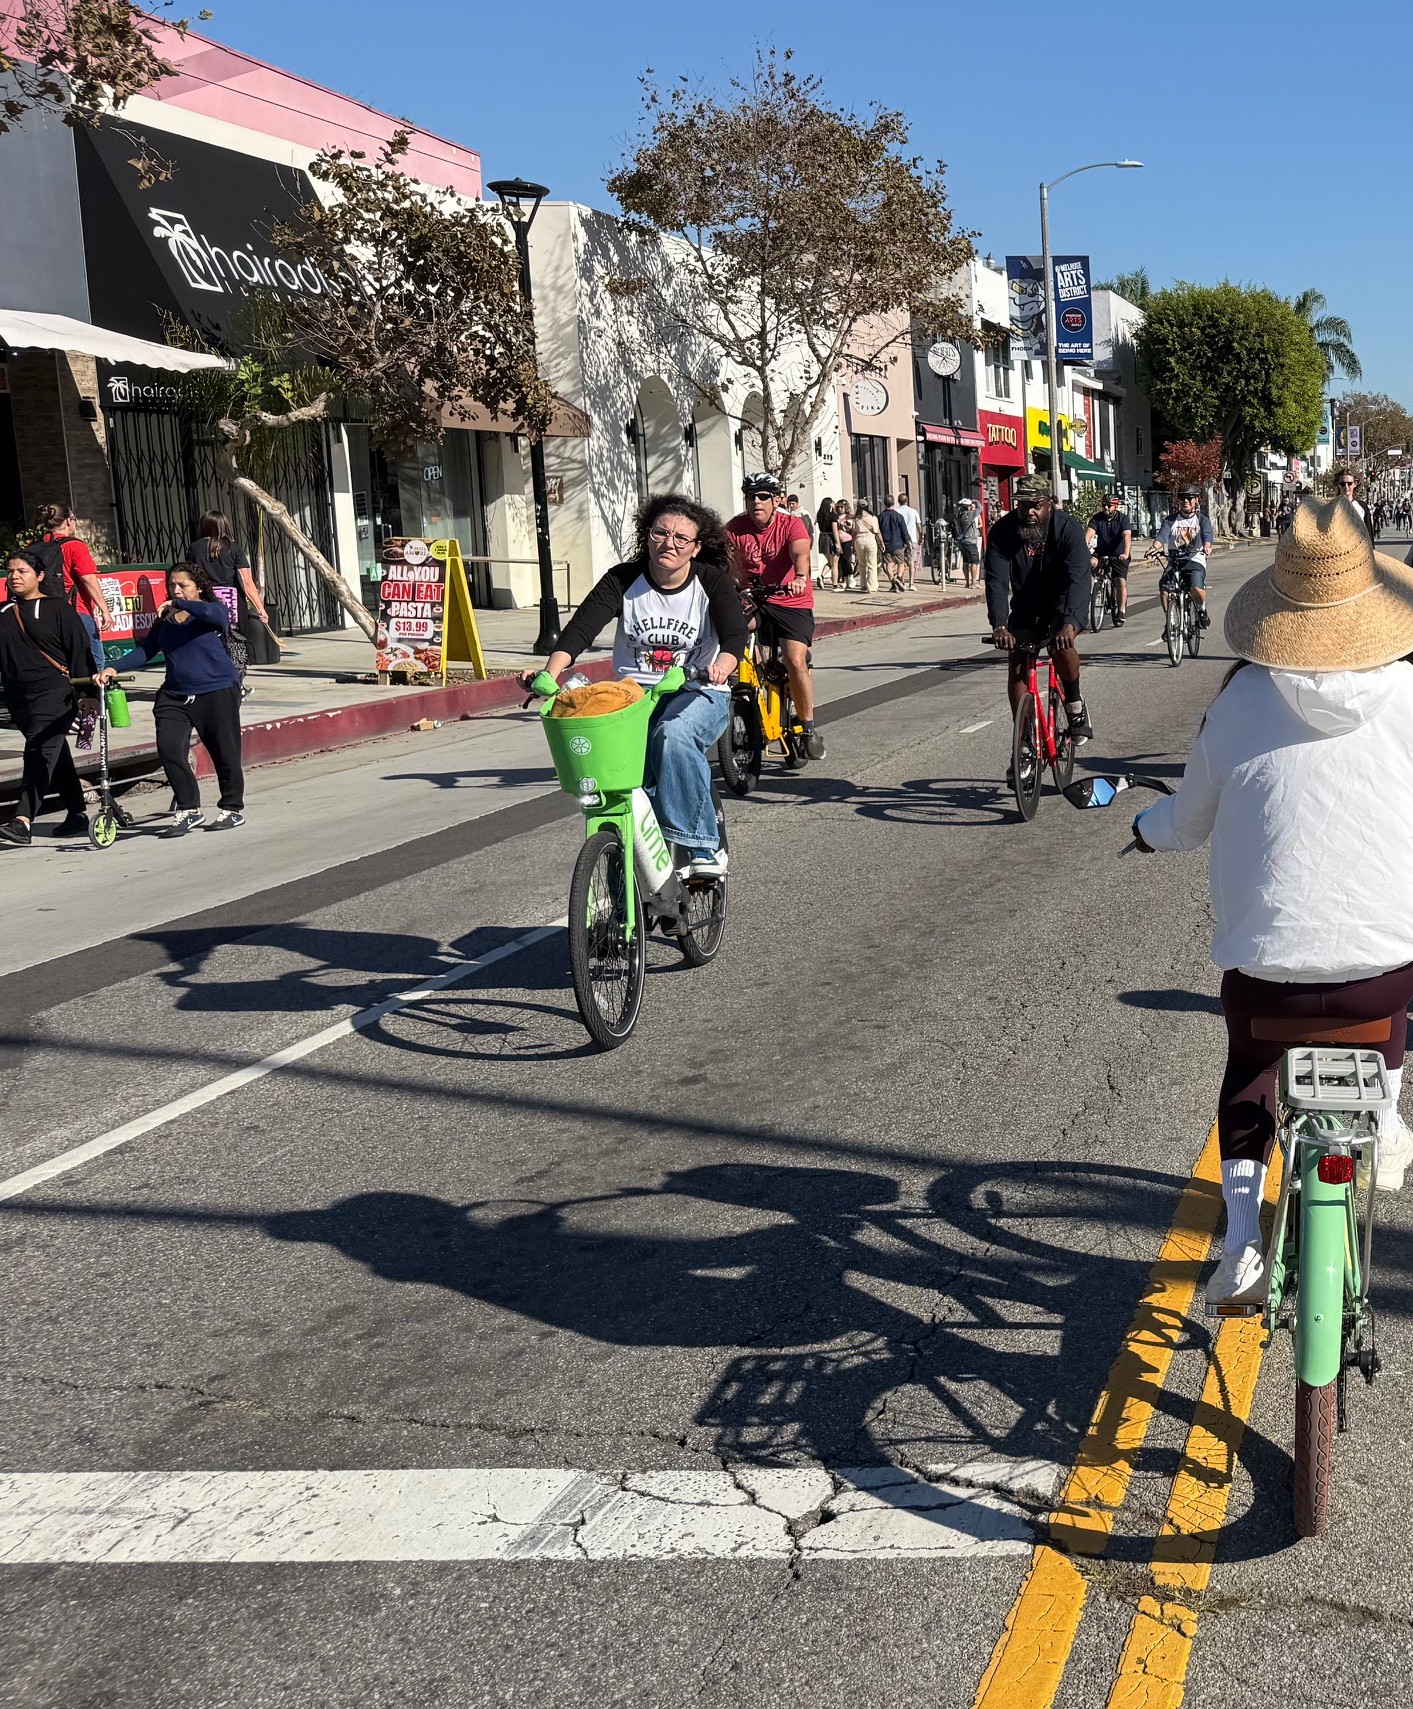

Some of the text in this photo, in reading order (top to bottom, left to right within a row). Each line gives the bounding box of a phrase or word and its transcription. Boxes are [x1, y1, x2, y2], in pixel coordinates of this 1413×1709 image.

[1057, 269, 1086, 289] ARTS
[1058, 285, 1087, 299] DISTRICT
[987, 424, 1017, 448] TATTOO
[424, 465, 443, 481] OPEN
[388, 566, 440, 582] ALL YOU
[381, 581, 444, 601] CAN EAT
[391, 602, 432, 618] PASTA
[395, 621, 428, 632] $13.99
[648, 633, 679, 645] CLUB
[641, 808, 670, 872] lime
